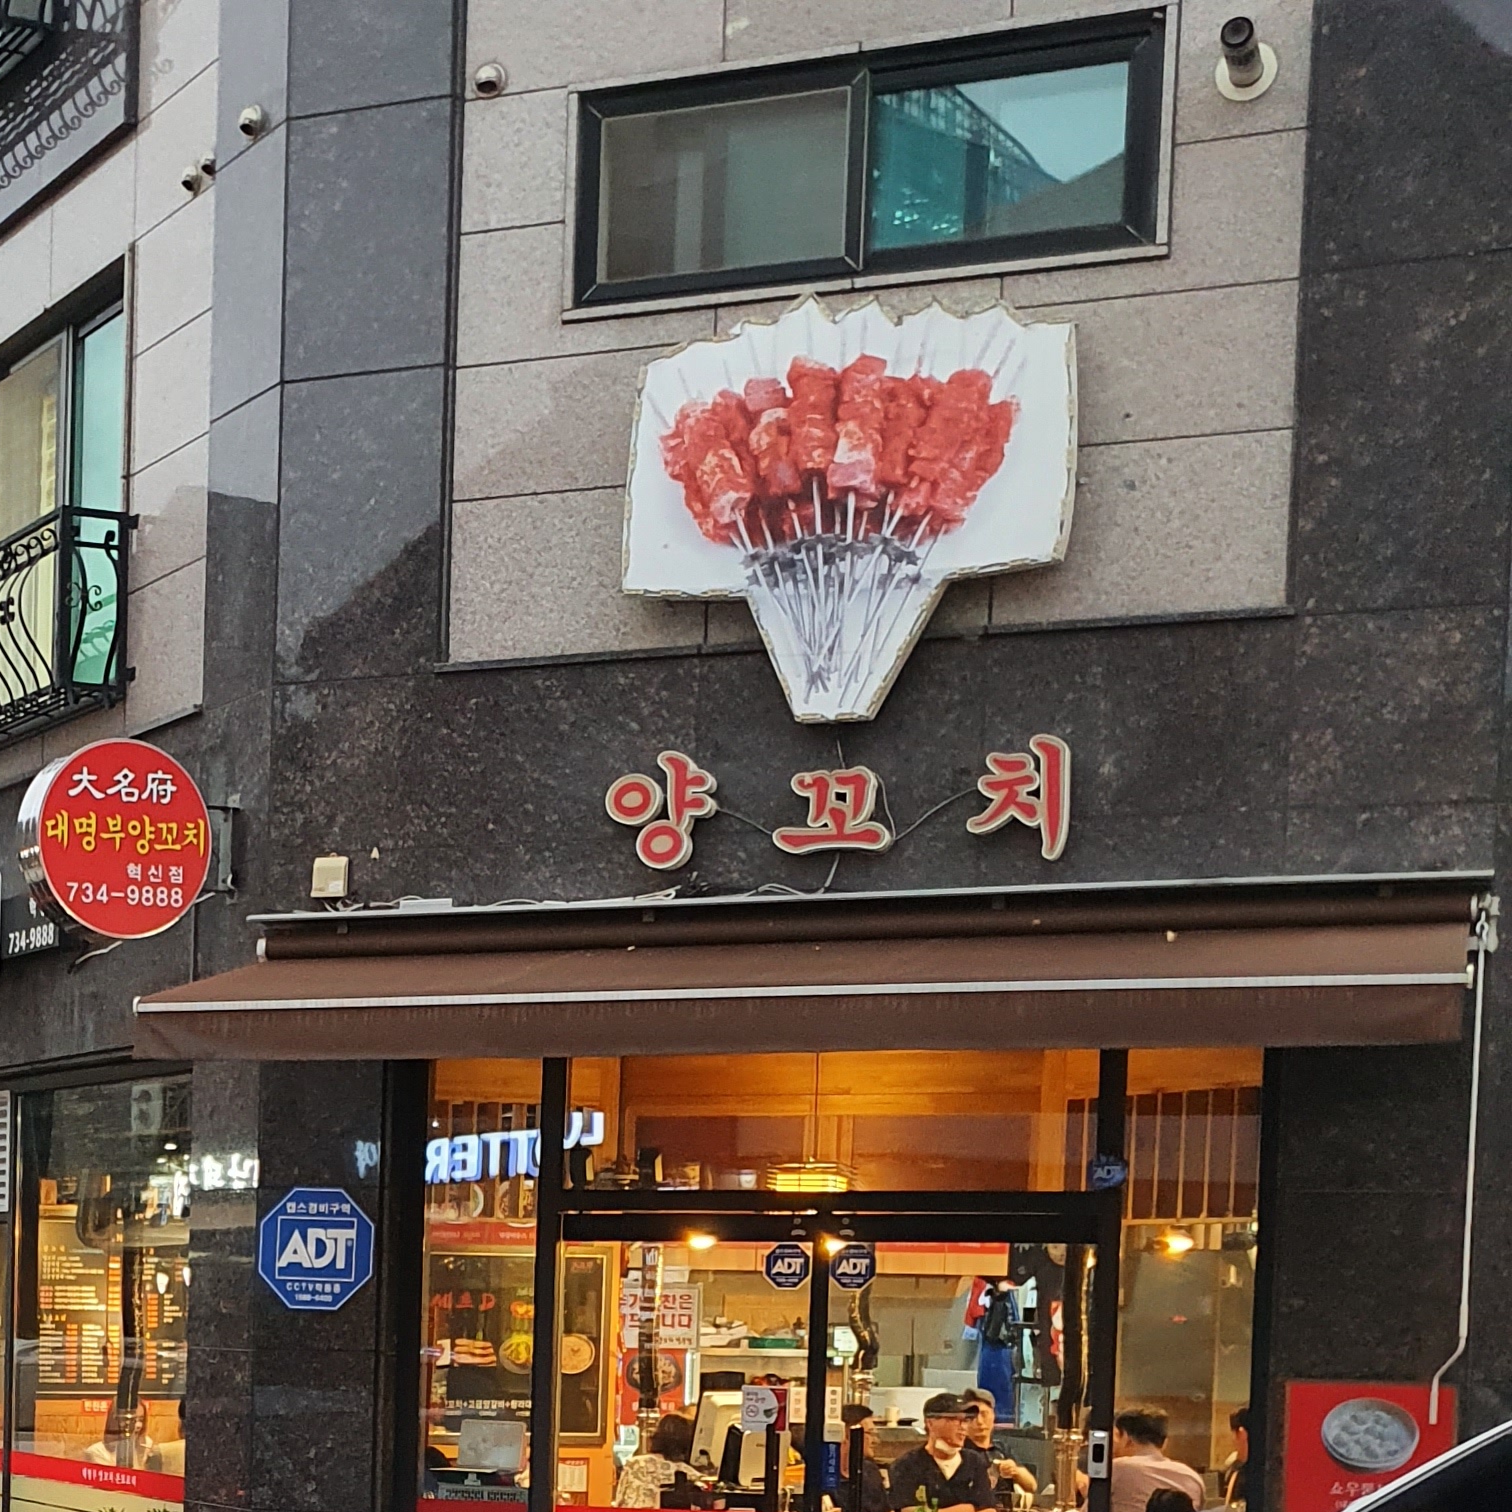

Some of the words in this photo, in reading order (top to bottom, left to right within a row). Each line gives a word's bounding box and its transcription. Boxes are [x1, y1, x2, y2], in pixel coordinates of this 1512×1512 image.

[68, 766, 178, 804] 大名府
[605, 734, 1071, 870] 양꼬치
[45, 810, 205, 857] 대명부양꼬치
[127, 862, 184, 884] 혁신점
[67, 882, 183, 908] 734-9888
[8, 922, 54, 954] 734-9888
[277, 1227, 356, 1270] ADT
[771, 1257, 805, 1275] ADT
[836, 1258, 870, 1275] ADT
